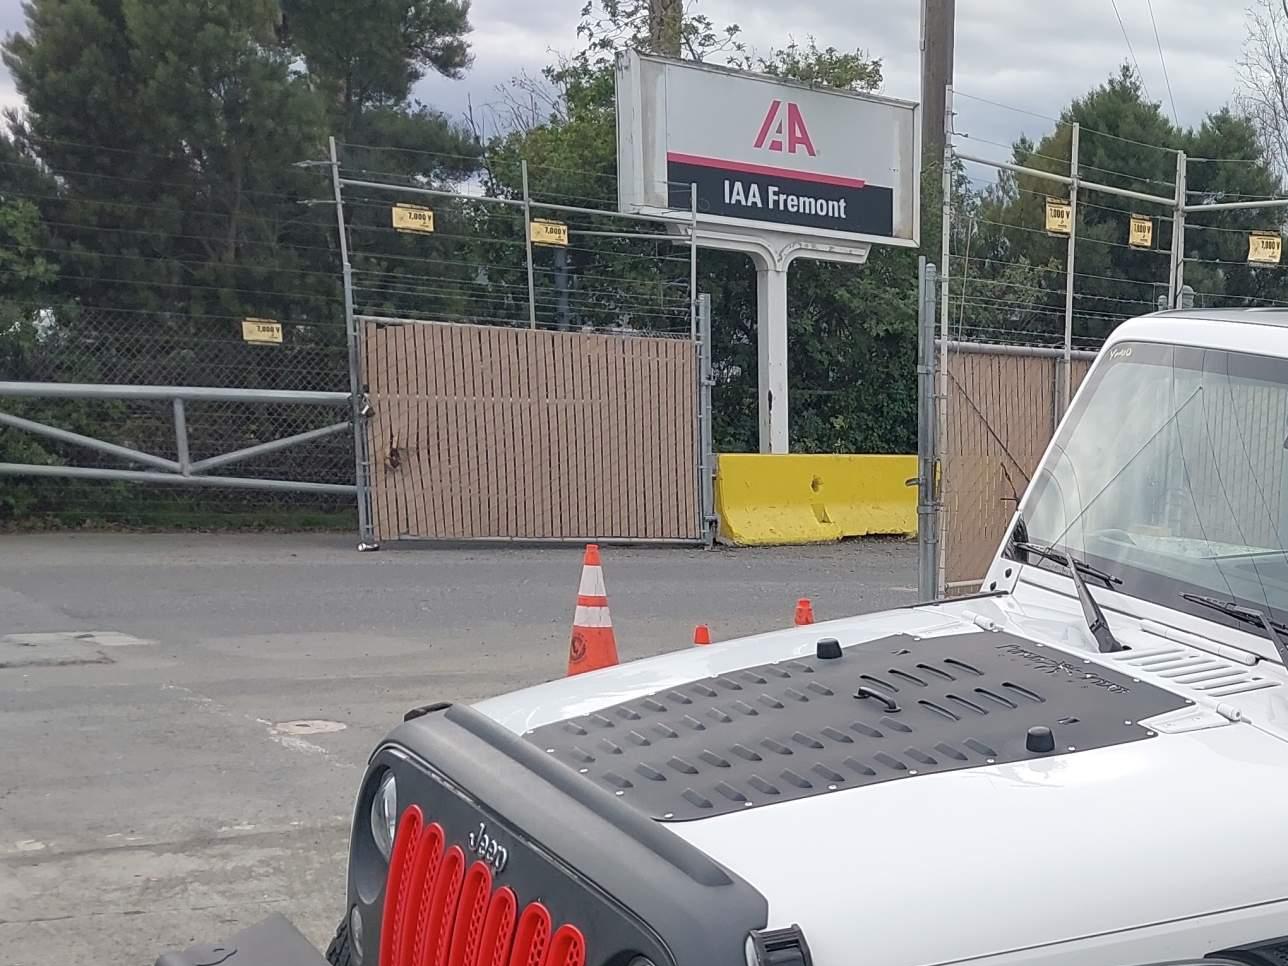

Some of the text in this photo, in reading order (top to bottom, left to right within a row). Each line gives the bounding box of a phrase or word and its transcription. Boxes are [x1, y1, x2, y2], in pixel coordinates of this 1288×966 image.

[723, 179, 845, 218] IAA Fremont
[469, 822, 508, 876] Jeep
